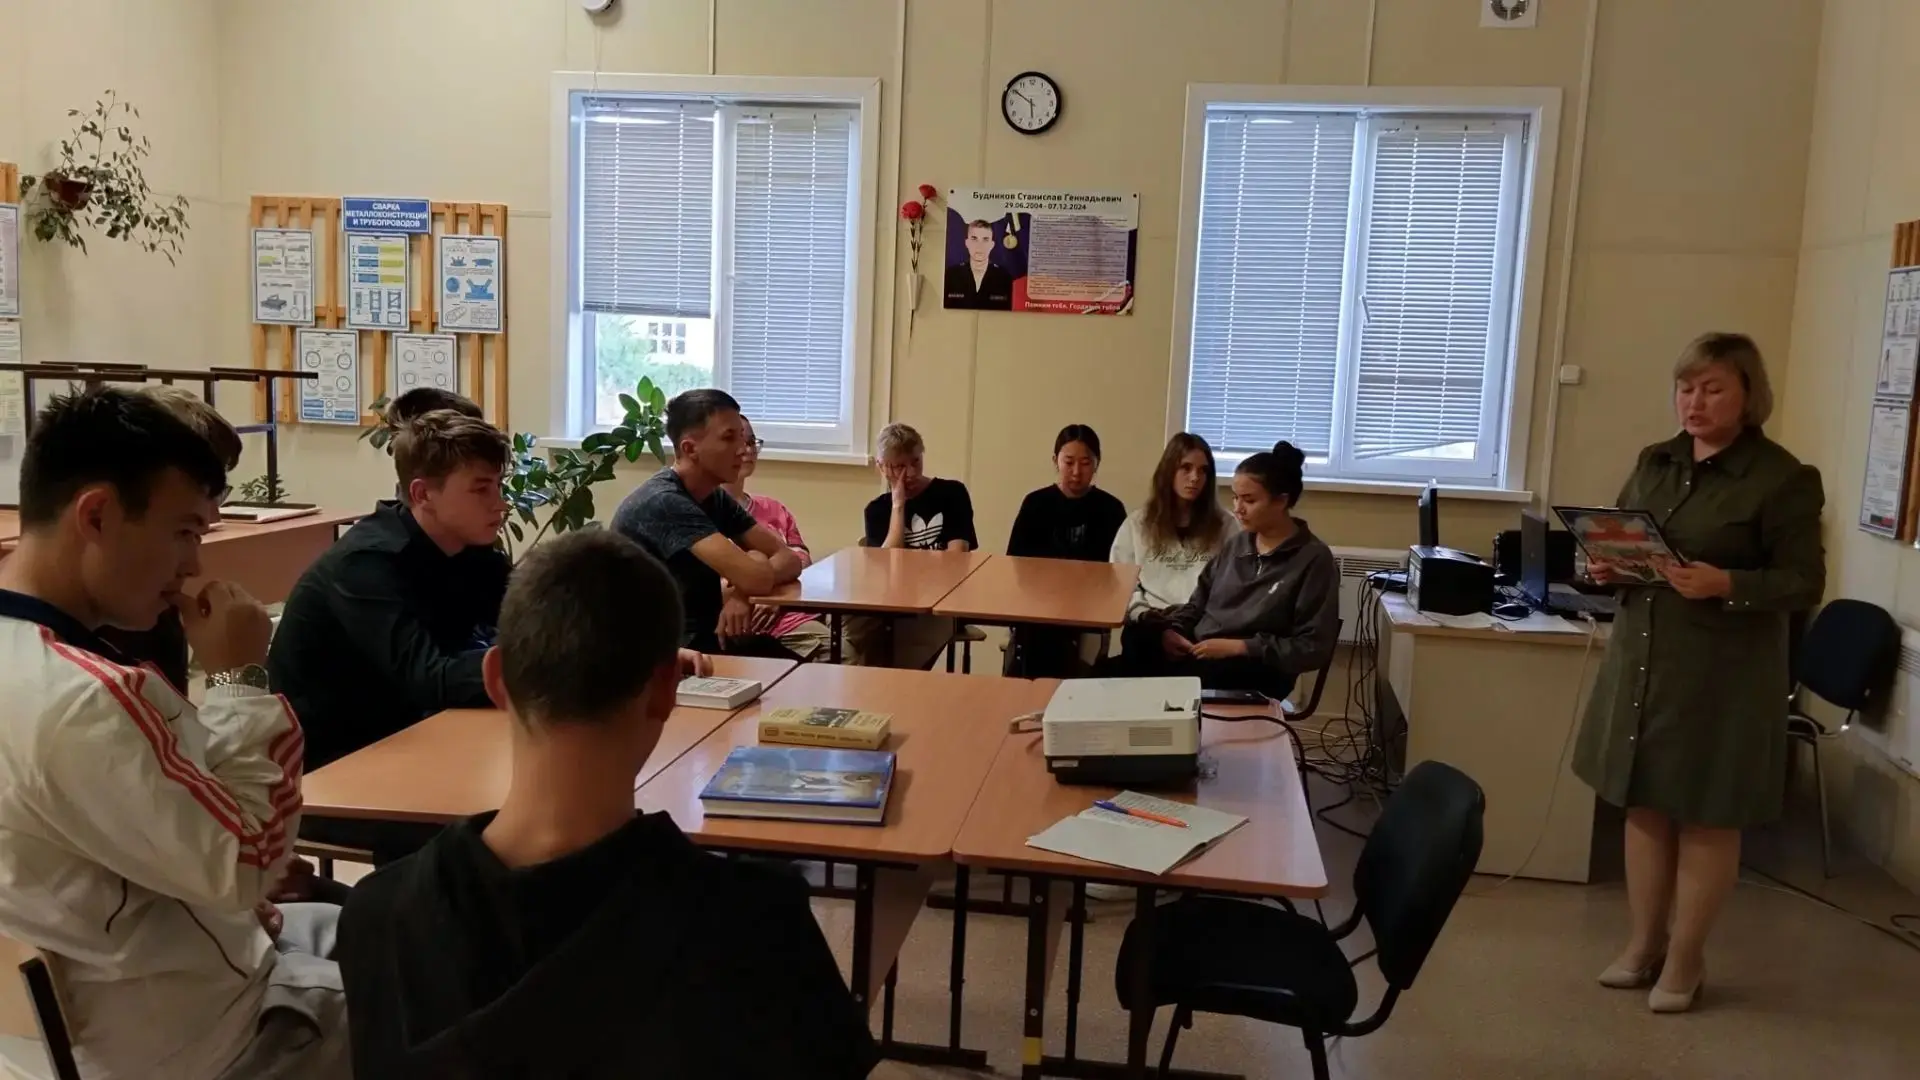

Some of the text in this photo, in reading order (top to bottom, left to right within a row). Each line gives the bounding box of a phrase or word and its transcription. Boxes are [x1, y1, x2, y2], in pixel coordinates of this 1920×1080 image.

[973, 191, 1122, 203] Будников Станислав Геннадьевич
[360, 219, 420, 227] ТРУБОПРОВОДОВ
